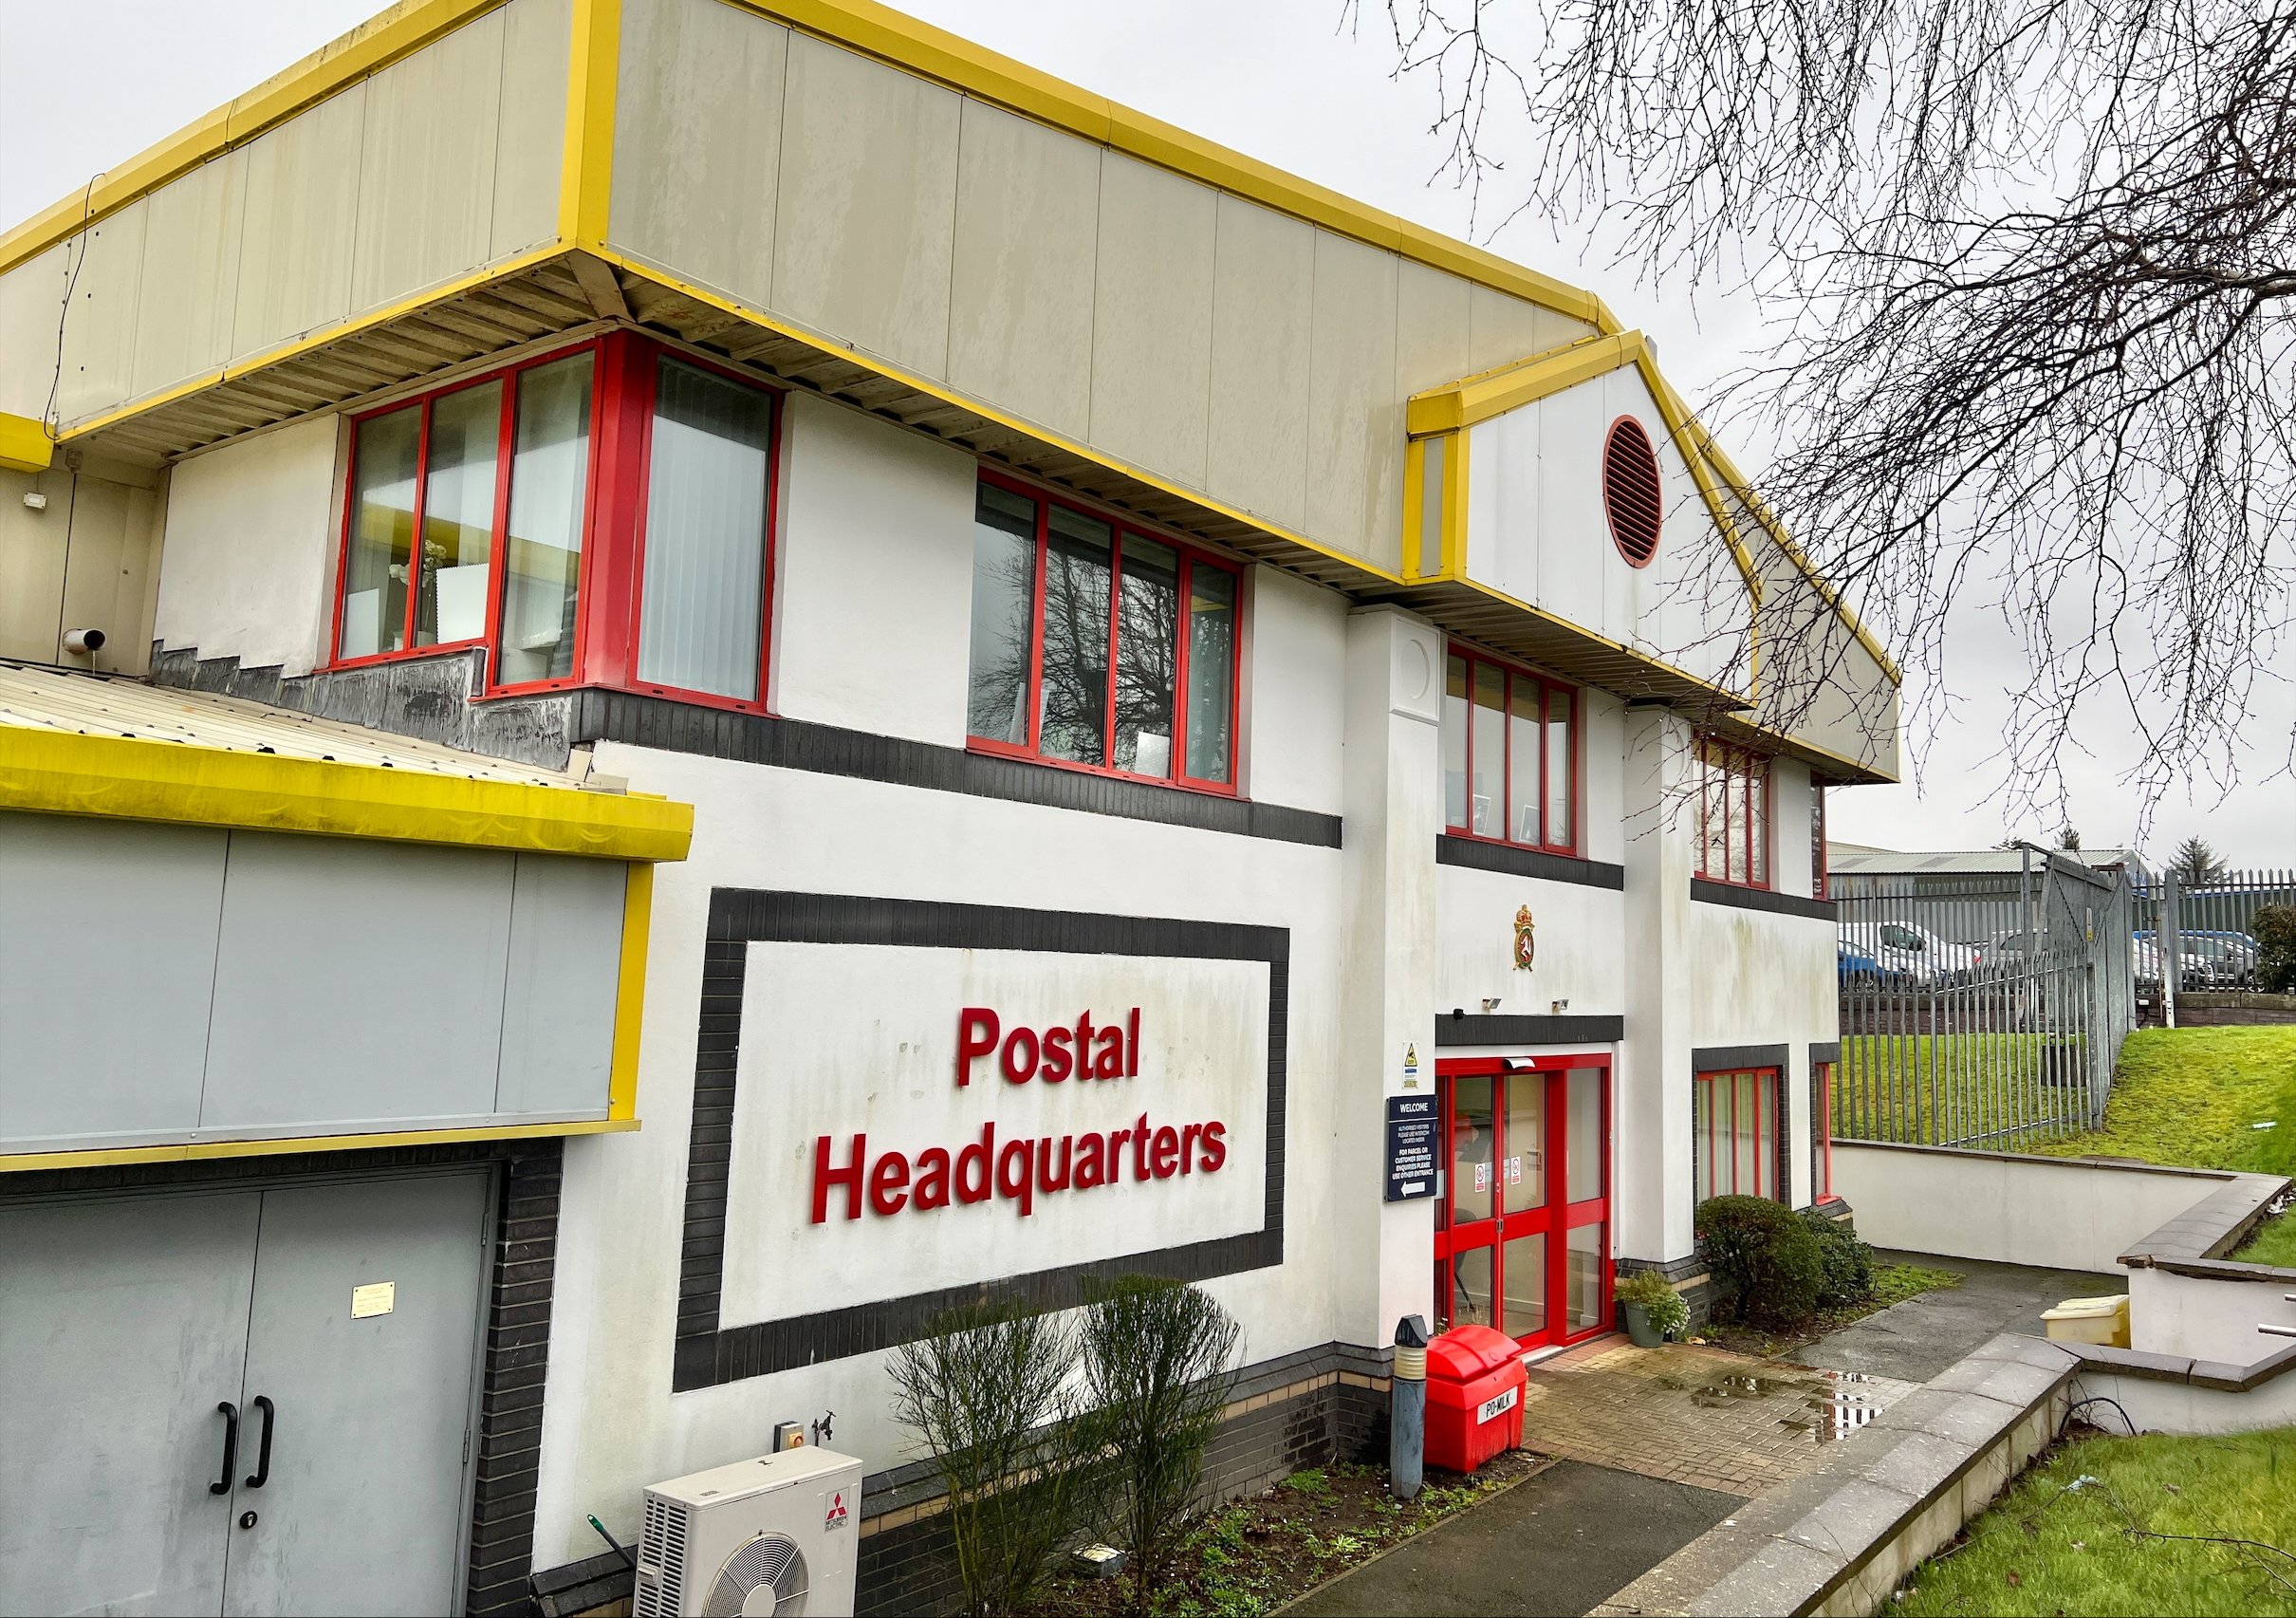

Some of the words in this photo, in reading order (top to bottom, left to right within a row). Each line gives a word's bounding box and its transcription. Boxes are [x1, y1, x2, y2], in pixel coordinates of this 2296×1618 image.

[957, 1008, 1140, 1087] Postal
[1400, 1103, 1428, 1113] WELCOME
[1395, 1155, 1416, 1163] CUSTOMER
[811, 1111, 1227, 1224] Headquarters
[1396, 1163, 1416, 1172] ENQUIRIES
[1415, 1168, 1434, 1177] ENTRANCE
[1486, 1392, 1510, 1418] PO-MILK
